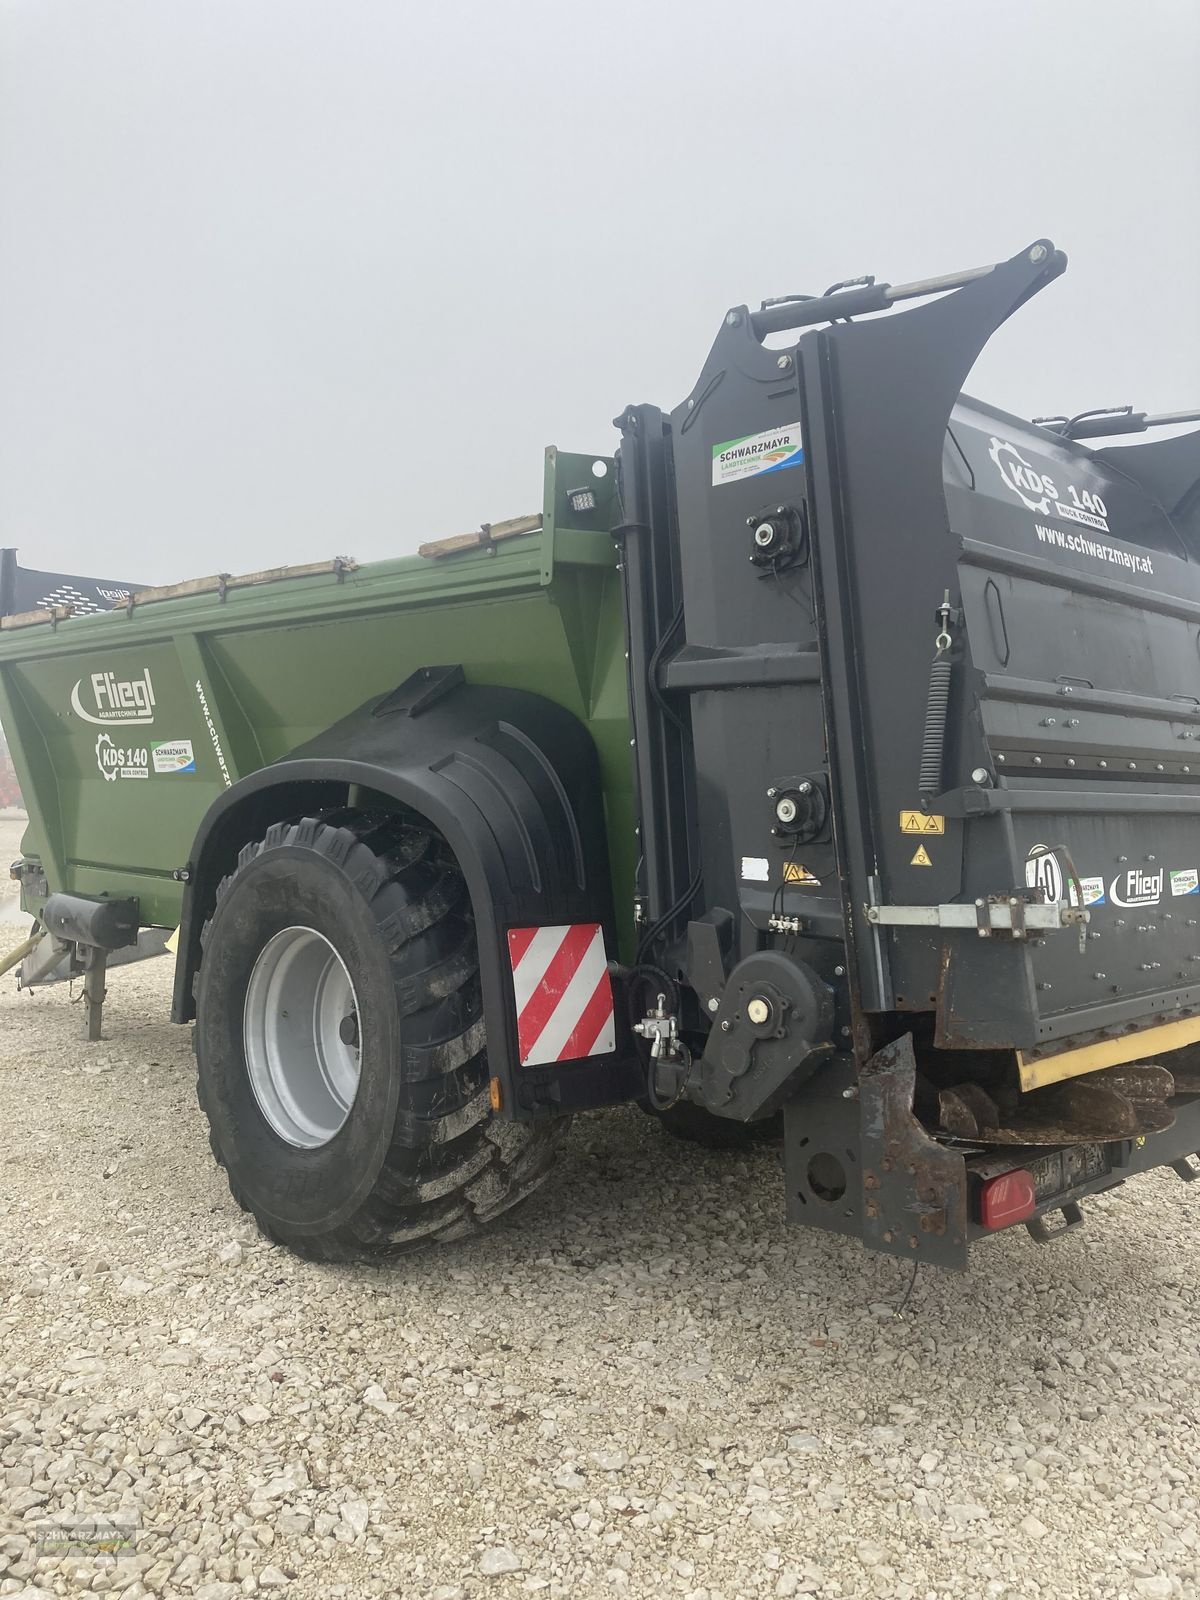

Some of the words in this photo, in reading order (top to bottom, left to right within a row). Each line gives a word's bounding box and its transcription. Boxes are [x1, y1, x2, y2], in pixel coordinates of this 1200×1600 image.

[720, 436, 790, 462] SCHWARZMAYR
[721, 455, 761, 470] LANDTECHNIK
[1009, 462, 1059, 499] KDS
[1067, 485, 1108, 518] 140
[1059, 506, 1078, 518] MUCK
[1079, 512, 1107, 529] CONTROL
[1035, 524, 1154, 575] www.schwarzmayr.at
[91, 668, 156, 716] Fliegl
[103, 748, 125, 766] KDS
[127, 748, 148, 766] 140
[155, 748, 188, 756] SCHWARZMAYR
[1127, 868, 1163, 899] Fliegl
